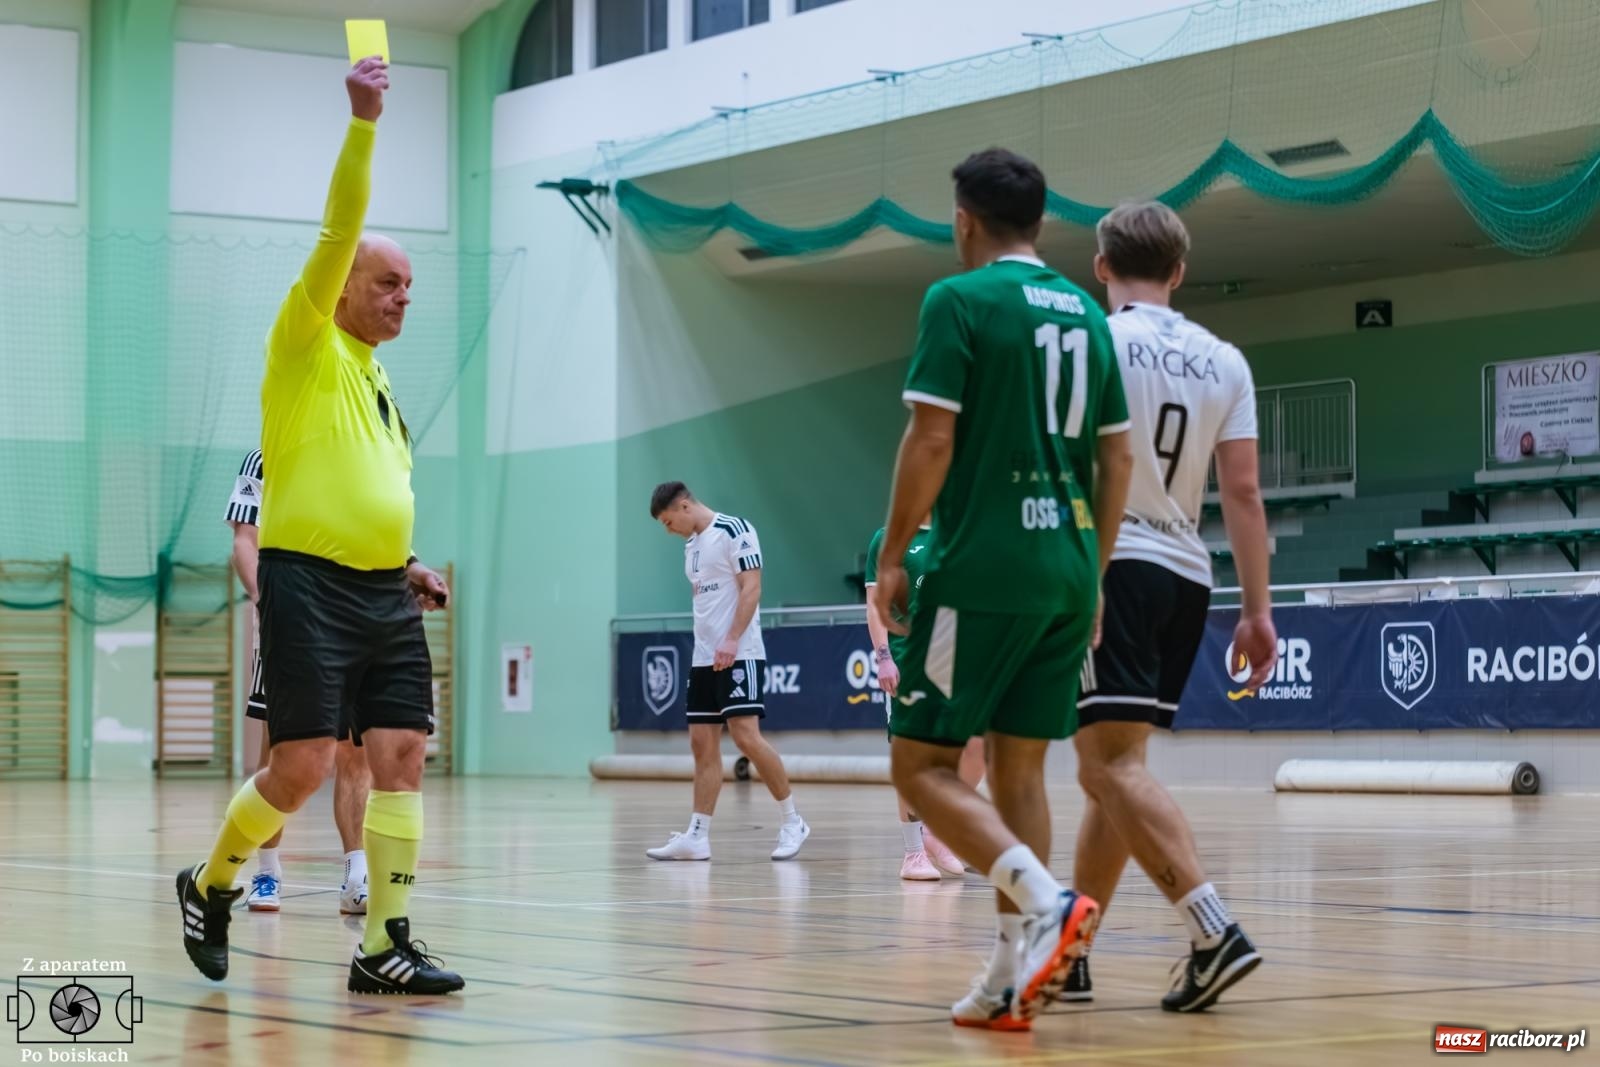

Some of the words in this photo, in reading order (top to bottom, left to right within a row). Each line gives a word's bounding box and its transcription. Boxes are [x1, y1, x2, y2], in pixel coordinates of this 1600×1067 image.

[1361, 309, 1386, 325] A
[1034, 322, 1088, 439] 11
[1127, 342, 1220, 384] RYCKA
[1506, 359, 1587, 388] MIESZKO
[1154, 402, 1189, 495] 9
[1467, 632, 1600, 684] RACIBÓ
[1258, 684, 1312, 700] RACIBÓRZ
